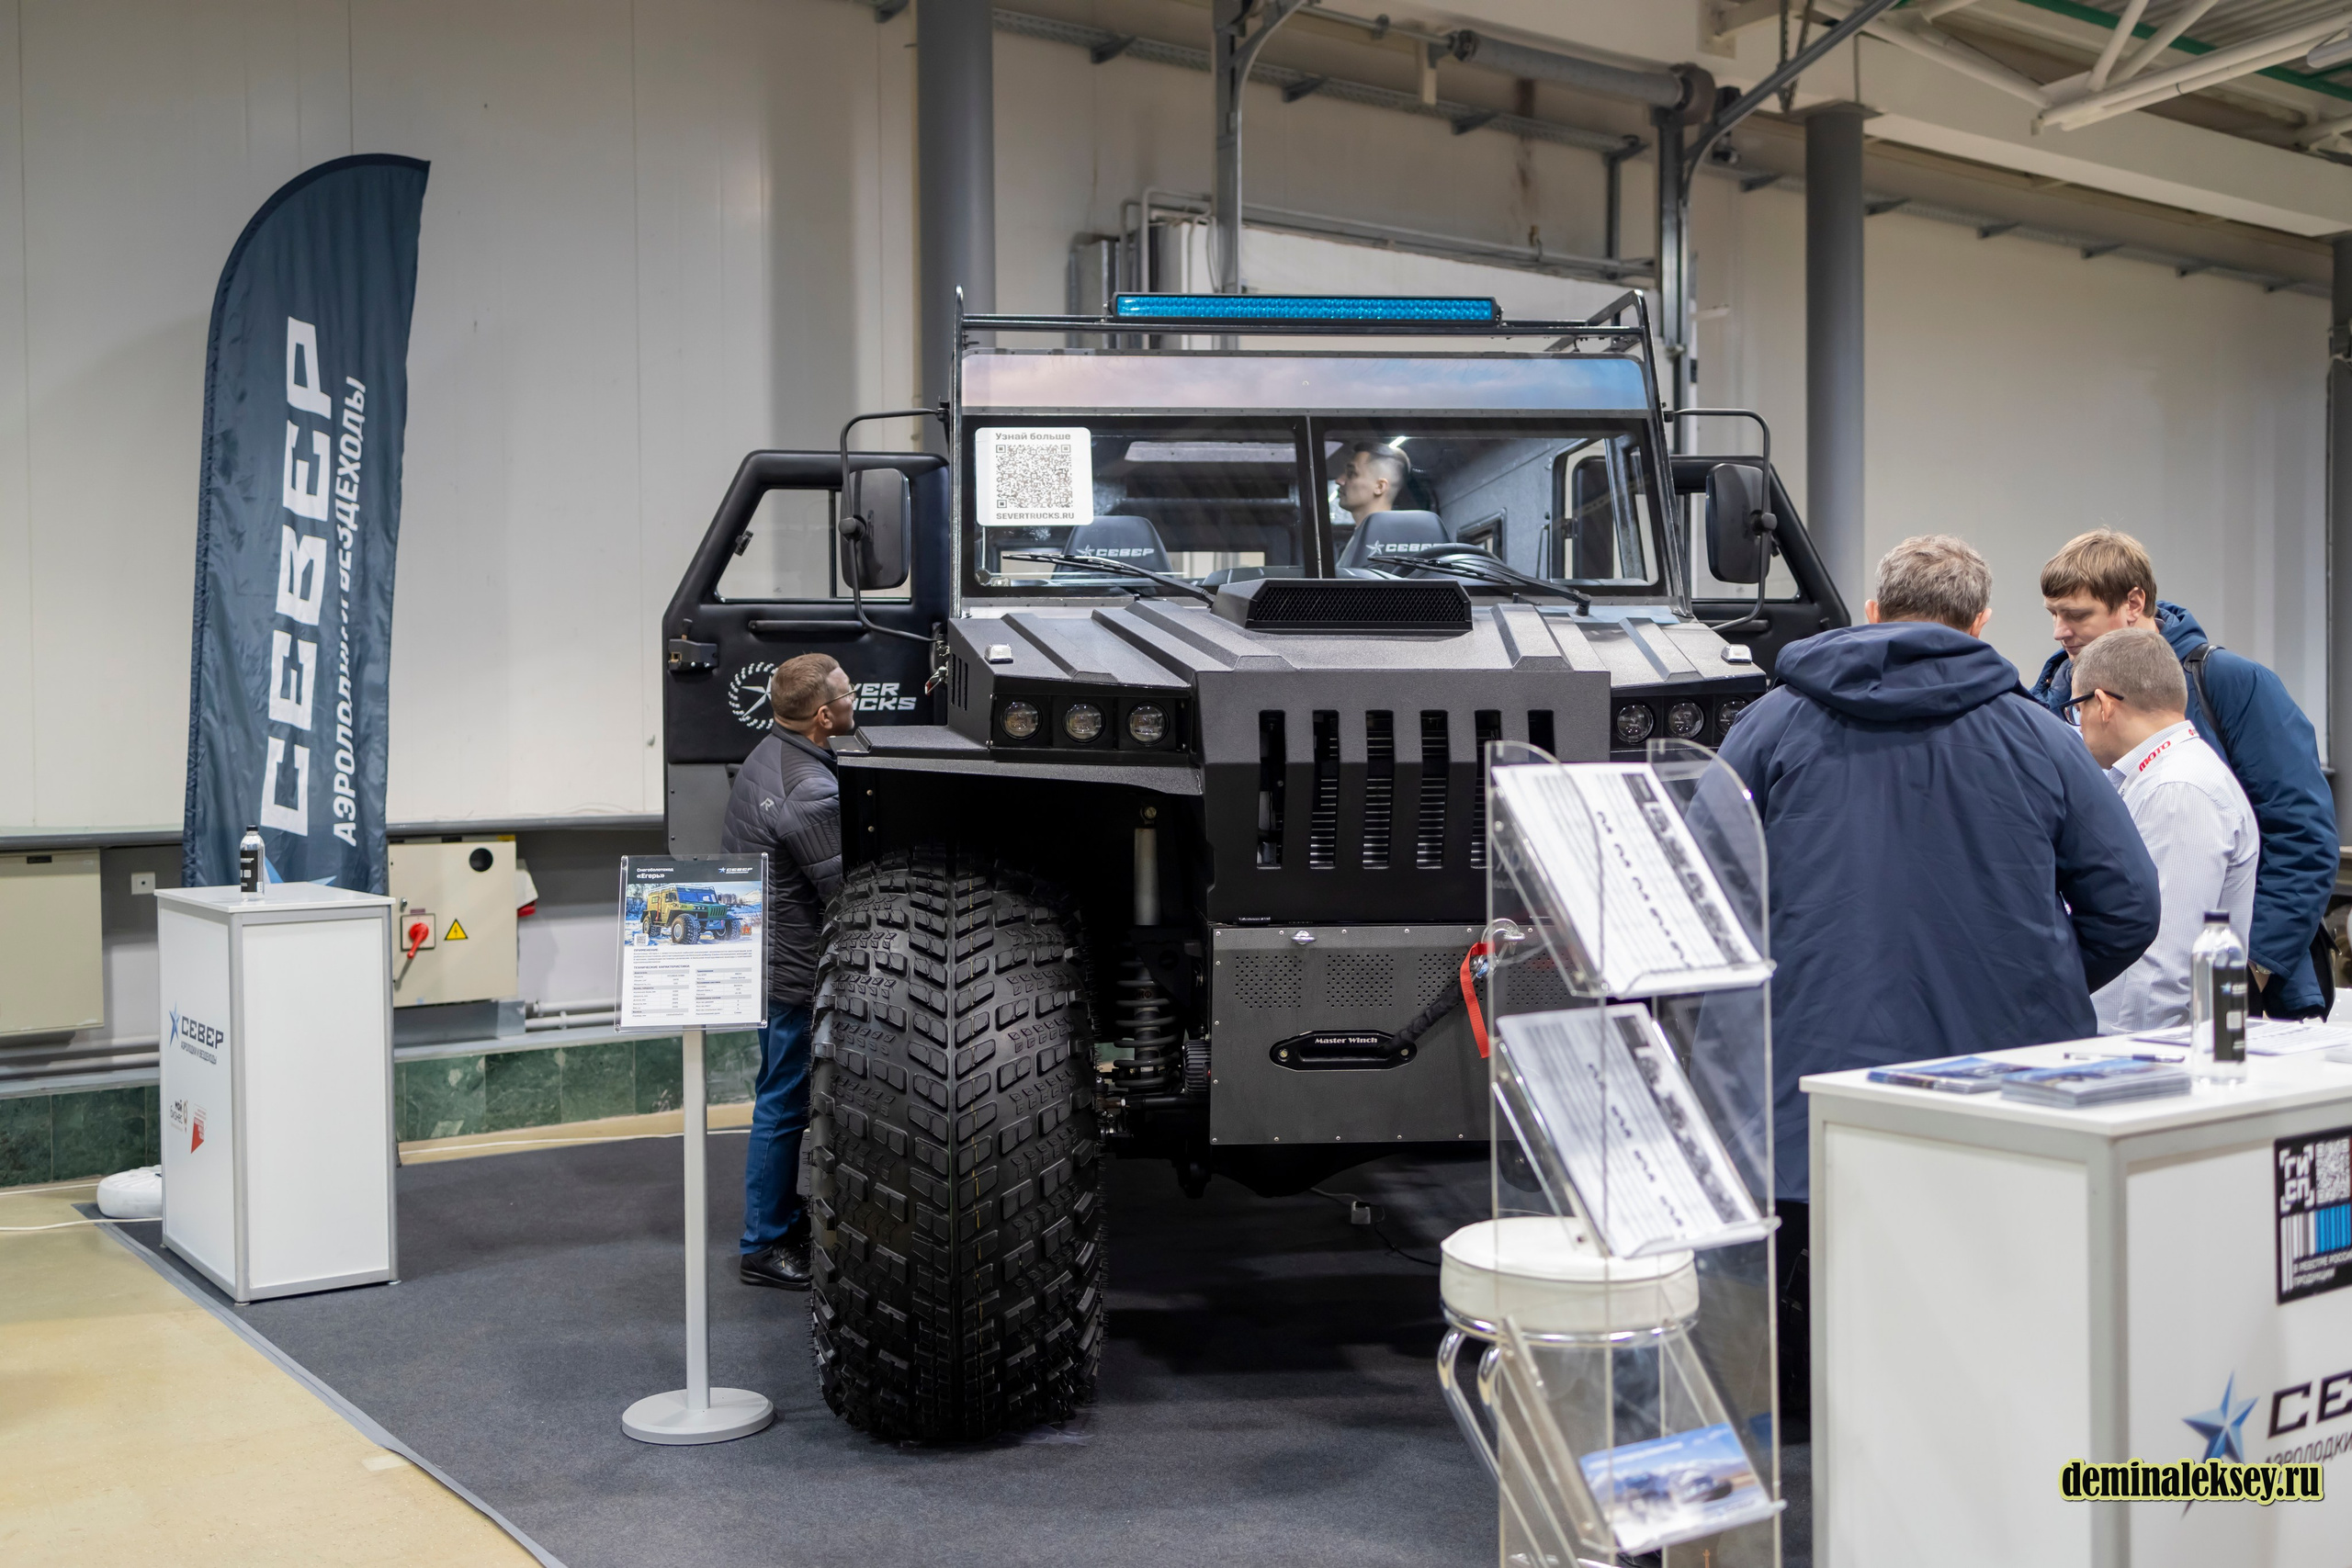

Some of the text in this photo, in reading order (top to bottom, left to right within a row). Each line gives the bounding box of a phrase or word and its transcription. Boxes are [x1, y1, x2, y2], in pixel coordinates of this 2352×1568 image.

[995, 432, 1071, 441] Узнай больше
[996, 512, 1075, 520] SEVERTRUCKS.RU
[1095, 547, 1155, 558] СЕВЕР
[260, 316, 332, 837] СЕВЕР
[181, 1015, 224, 1050] СЕВЕР
